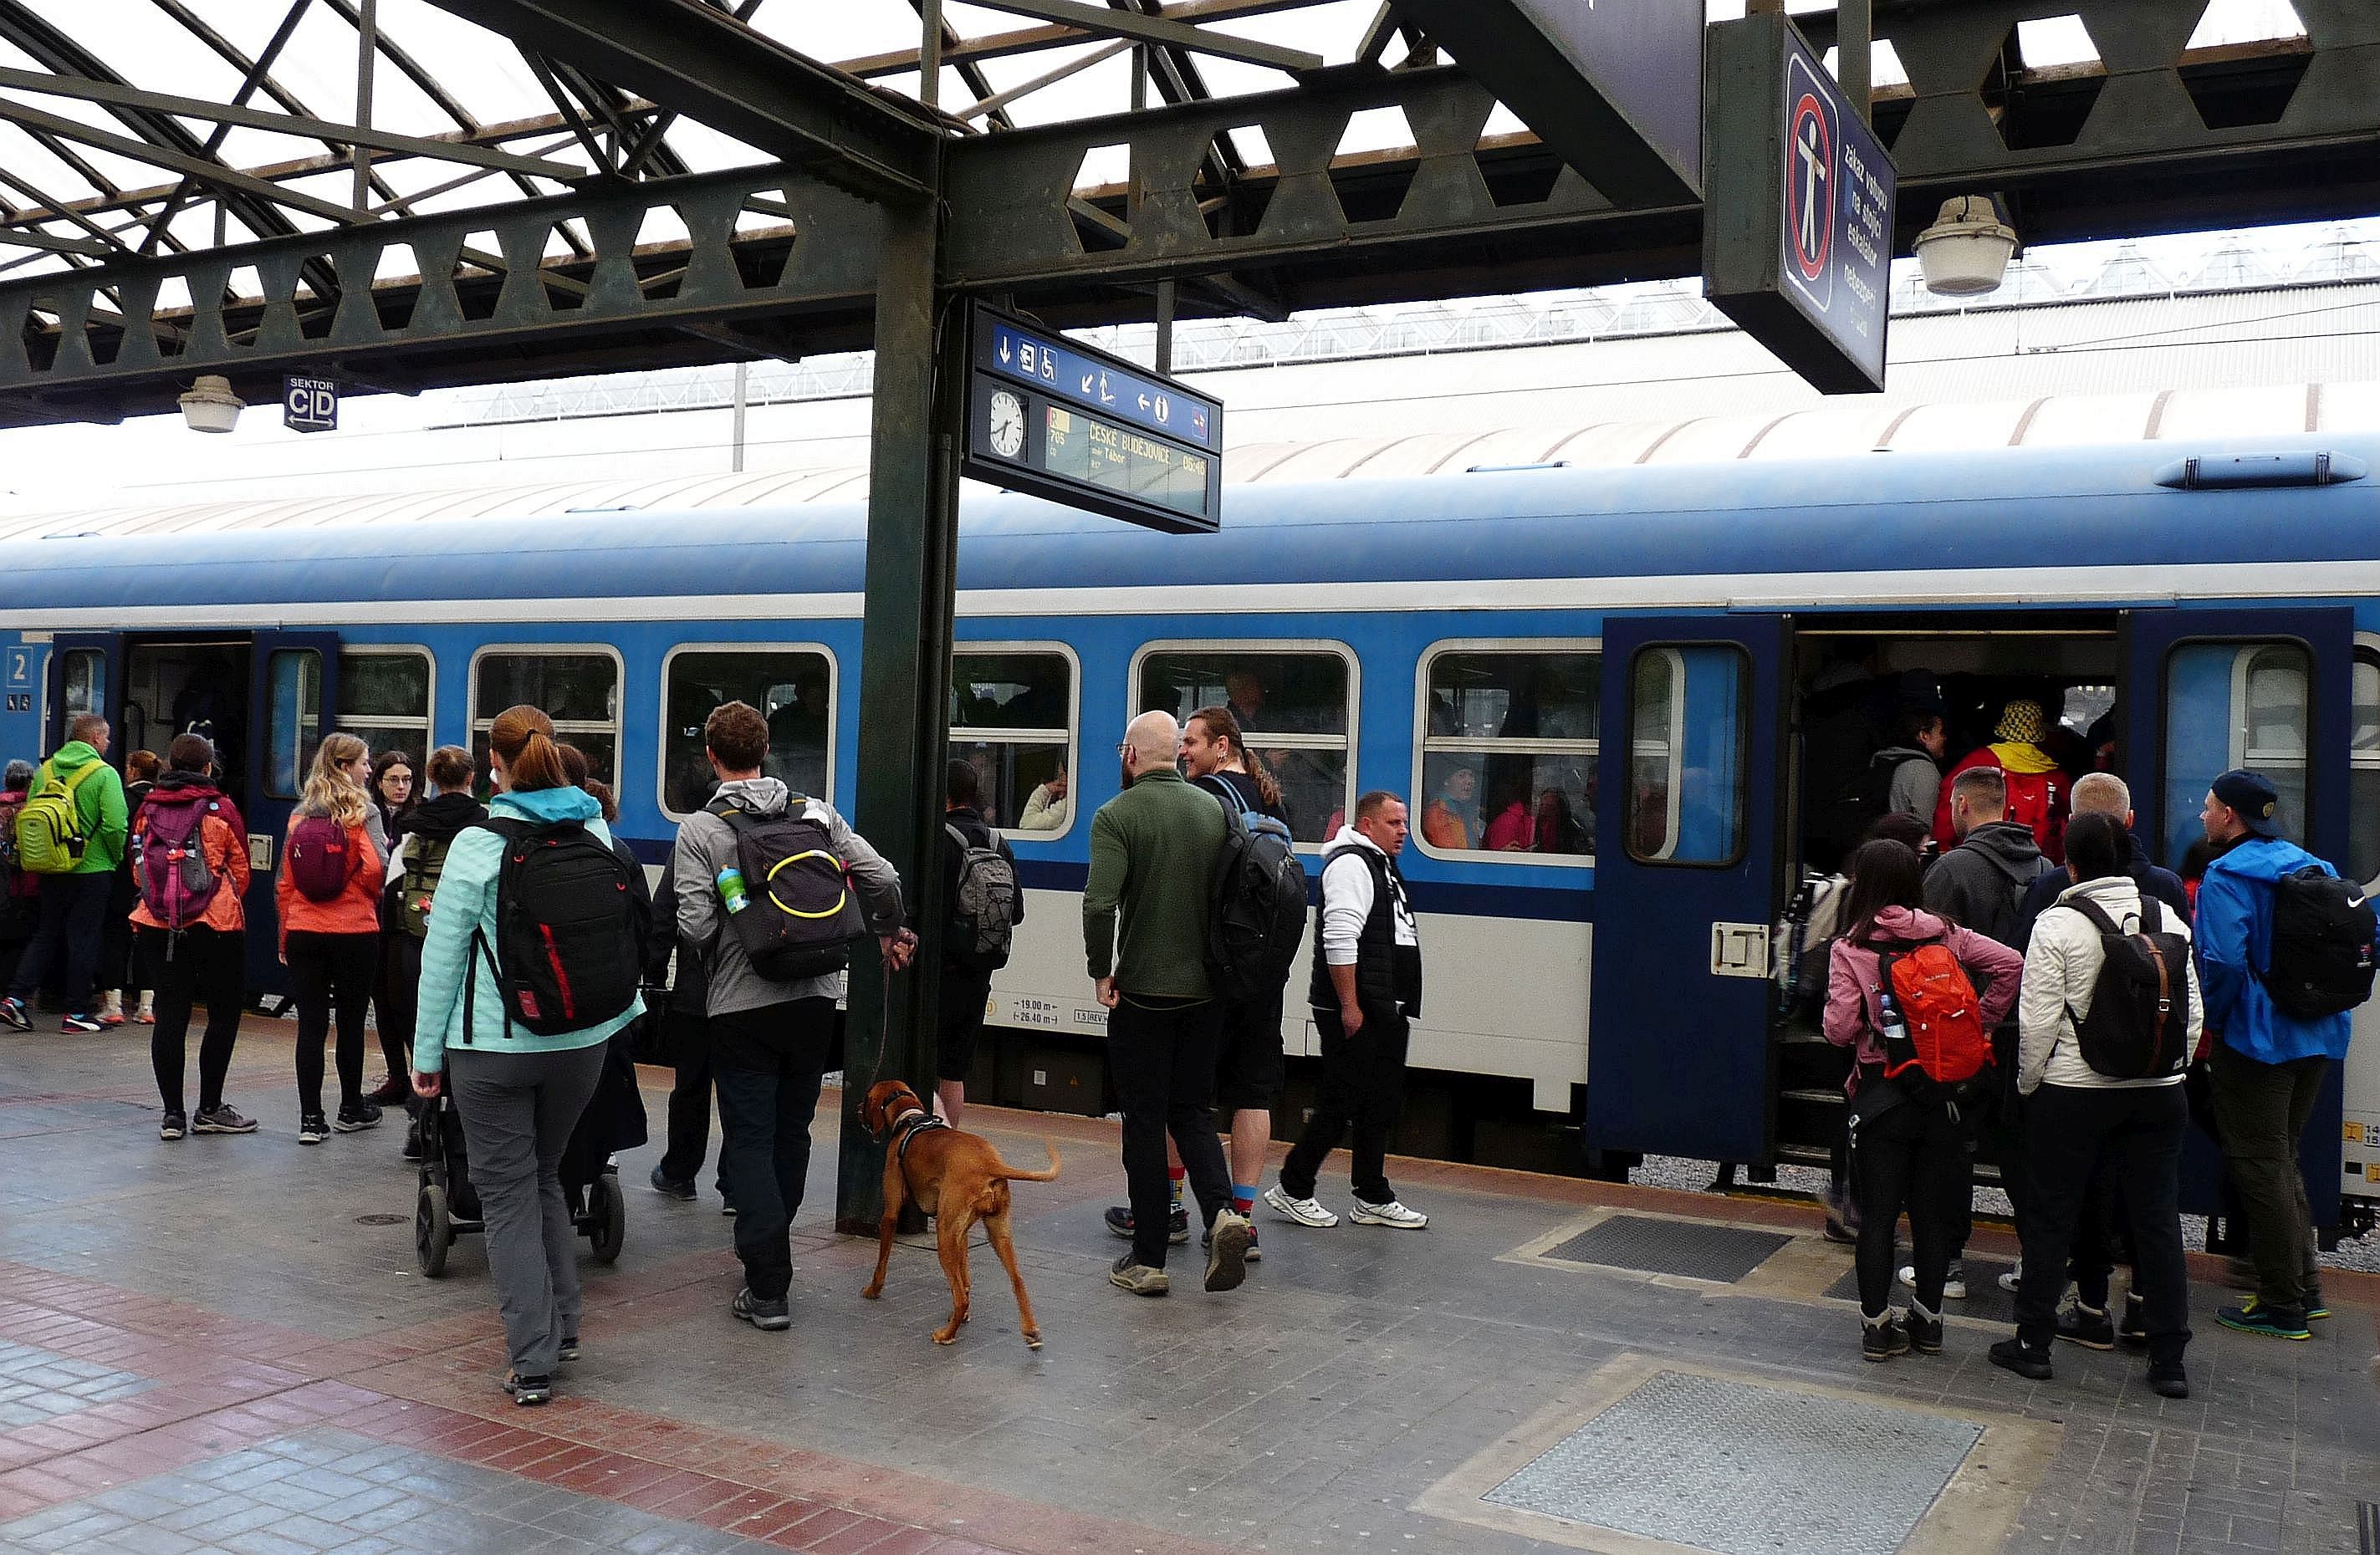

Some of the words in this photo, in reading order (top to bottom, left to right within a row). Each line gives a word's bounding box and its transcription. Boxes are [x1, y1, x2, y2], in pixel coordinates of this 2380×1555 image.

[1845, 143, 1864, 183] zákaz
[1866, 171, 1887, 212] vstupu
[1851, 191, 1861, 216] na
[289, 377, 335, 390] SEKTOR
[289, 388, 309, 415] C
[316, 390, 335, 416] D
[1050, 430, 1065, 445] 705
[1104, 446, 1126, 463] Tábor
[1090, 421, 1117, 446] ČESKÉ
[1121, 433, 1172, 464] BUDĚJOVICE
[13, 654, 27, 681] 2
[1021, 999, 1042, 1011] 19.00
